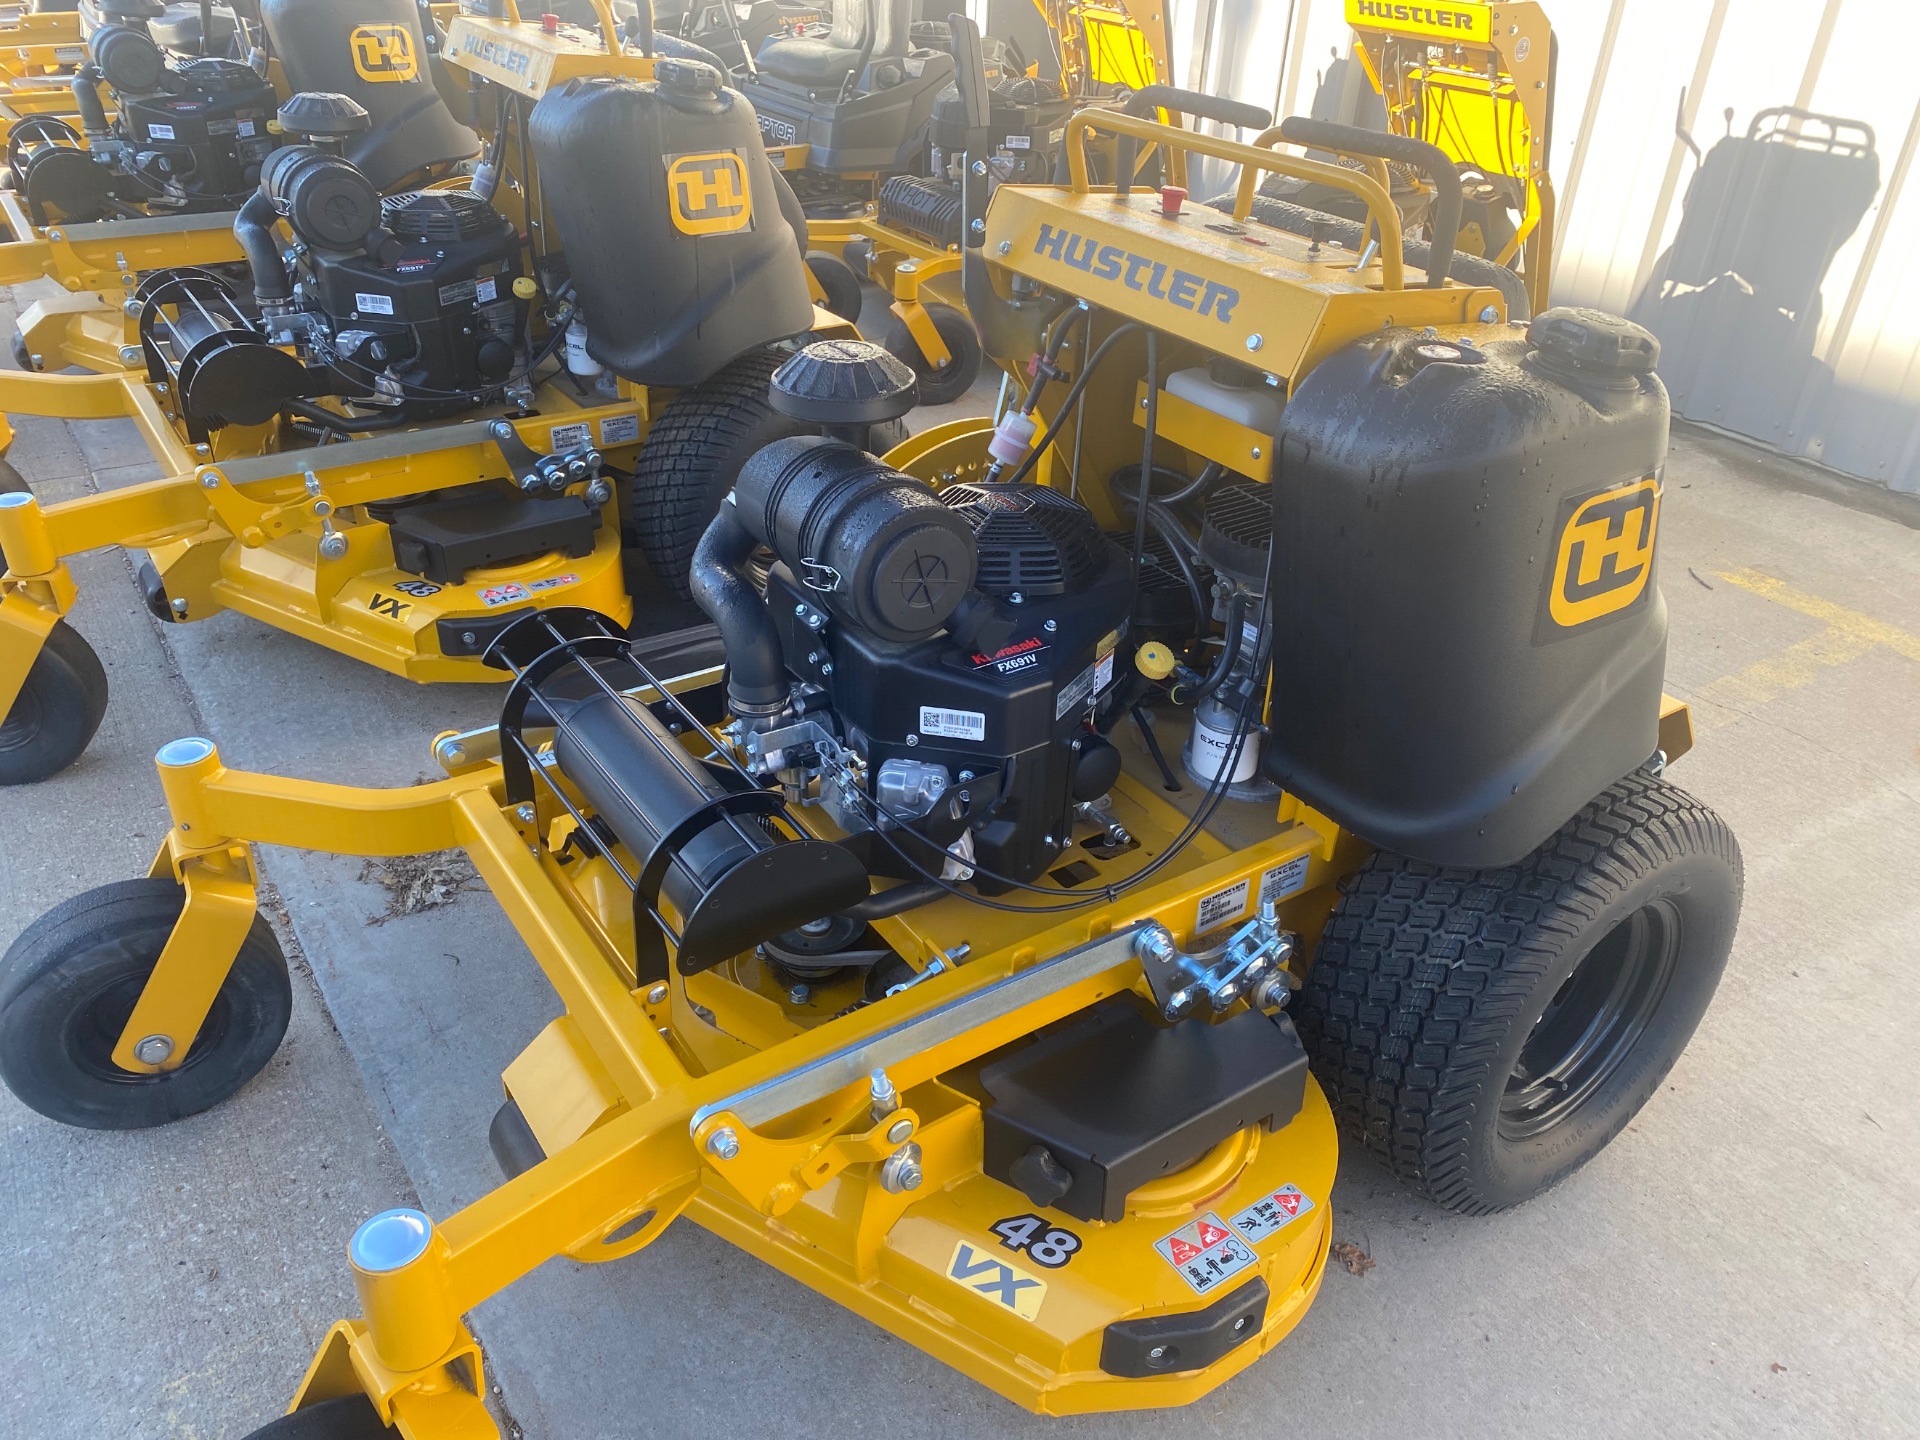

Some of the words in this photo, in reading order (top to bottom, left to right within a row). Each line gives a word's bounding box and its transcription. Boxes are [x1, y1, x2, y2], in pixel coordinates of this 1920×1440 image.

[1358, 0, 1473, 30] HUSTLER
[464, 33, 529, 77] HUSTLER
[756, 113, 796, 145] APTOR
[901, 186, 936, 210] HOT
[1033, 222, 1240, 325] HUSTLER
[393, 580, 442, 598] 48
[369, 593, 412, 619] VX
[970, 637, 1043, 665] Kwasaki
[997, 653, 1037, 673] FX691V
[989, 1213, 1083, 1269] 48
[949, 1243, 1043, 1310] VX
